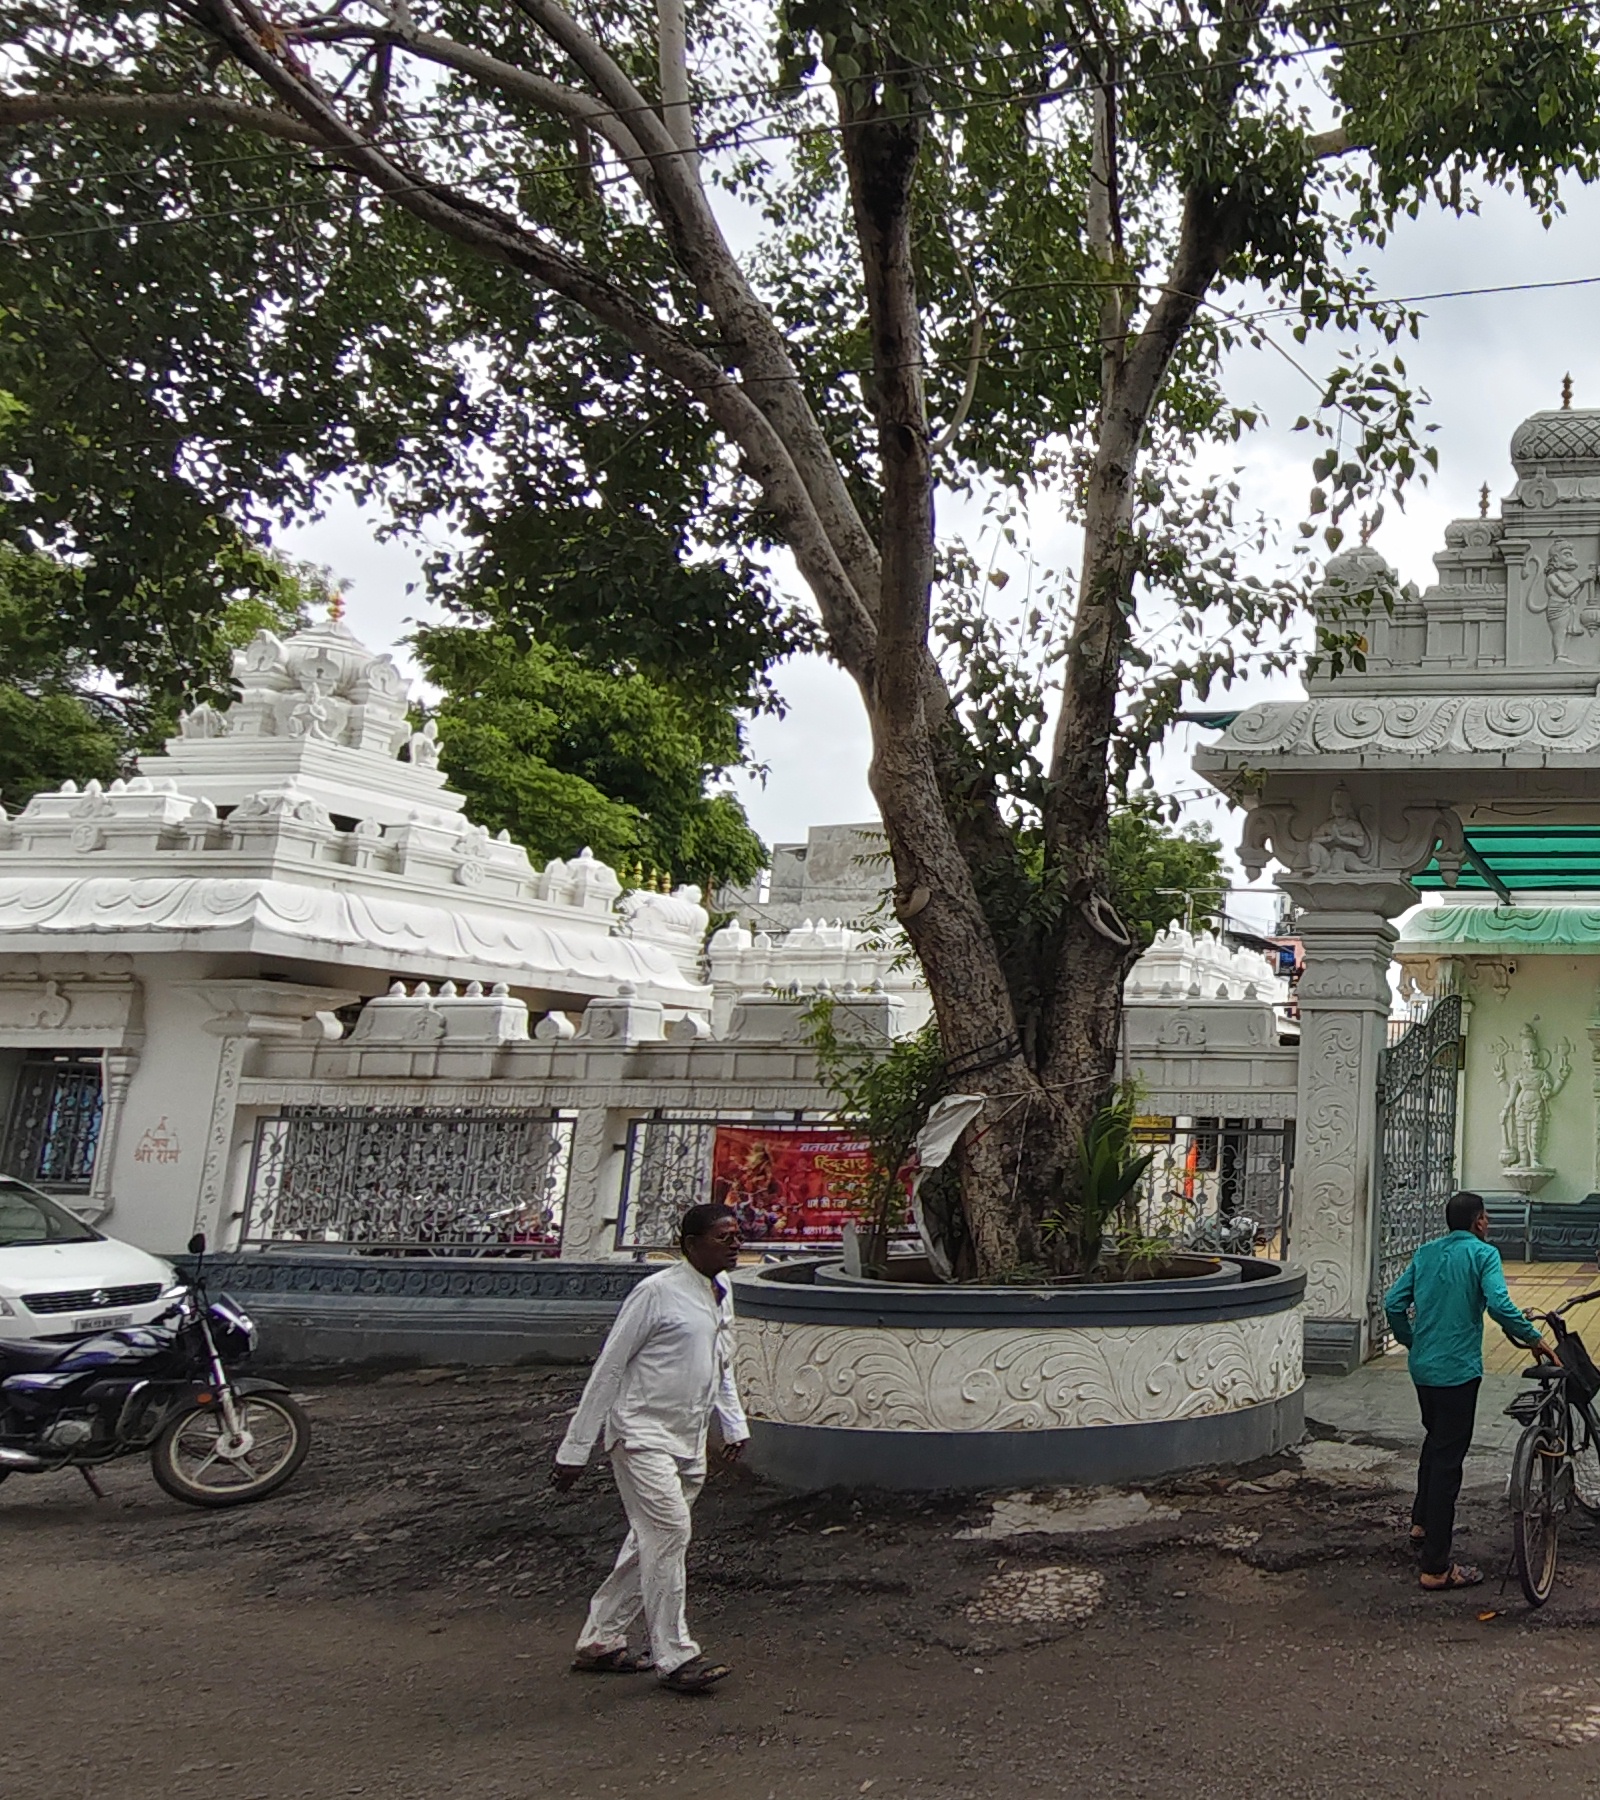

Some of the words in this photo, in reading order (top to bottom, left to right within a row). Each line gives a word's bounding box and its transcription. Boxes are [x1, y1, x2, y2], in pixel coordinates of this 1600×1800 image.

[152, 1138, 170, 1148] जय
[134, 1144, 154, 1163] श्री
[157, 1150, 182, 1164] राम
